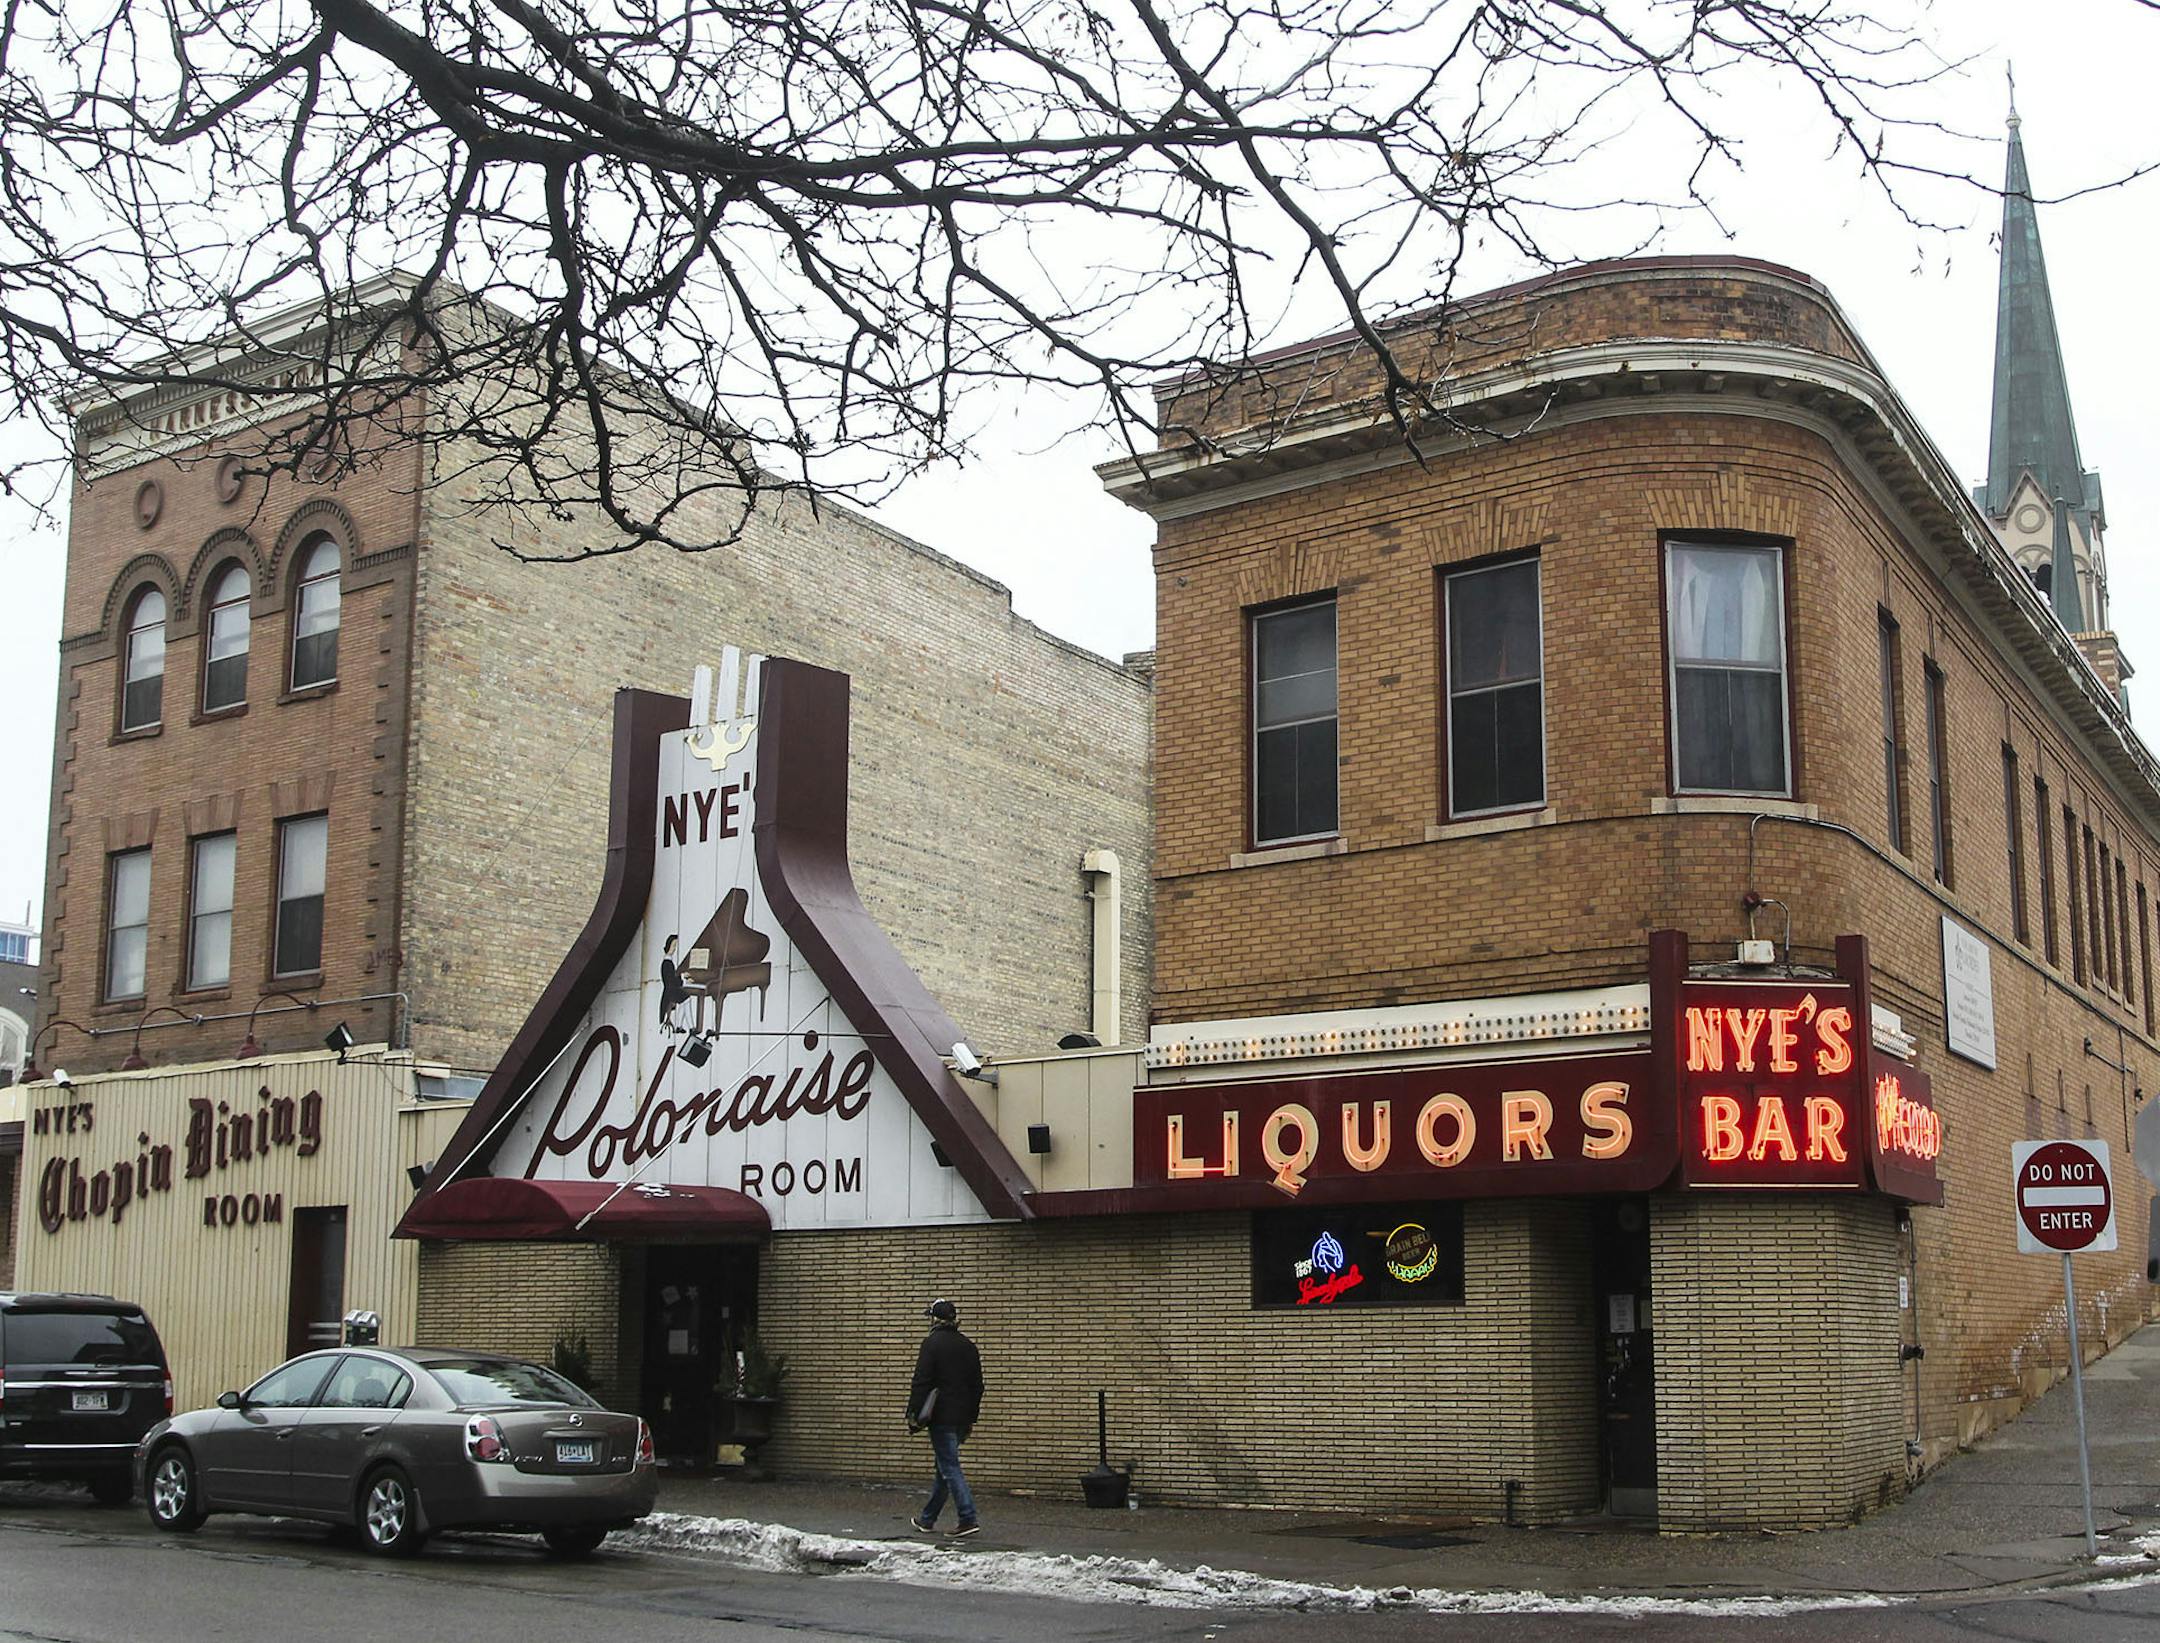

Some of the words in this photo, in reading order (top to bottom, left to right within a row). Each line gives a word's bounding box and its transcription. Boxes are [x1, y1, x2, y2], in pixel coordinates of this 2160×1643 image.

[663, 771, 757, 849] NYE'
[1685, 992, 1853, 1076] NYE'S
[33, 1102, 94, 1136] NYE'S
[523, 1024, 876, 1180] Polonaise
[1700, 1095, 1849, 1163] BAR
[38, 1131, 172, 1234] Chopin
[184, 1085, 323, 1179] Dining
[1166, 1080, 1634, 1199] LIQUORS
[2029, 1164, 2056, 1182] DO
[2061, 1163, 2096, 1181] NOT
[203, 1193, 282, 1228] ROOM
[740, 1156, 862, 1198] ROOM
[2039, 1211, 2093, 1231] ENTER
